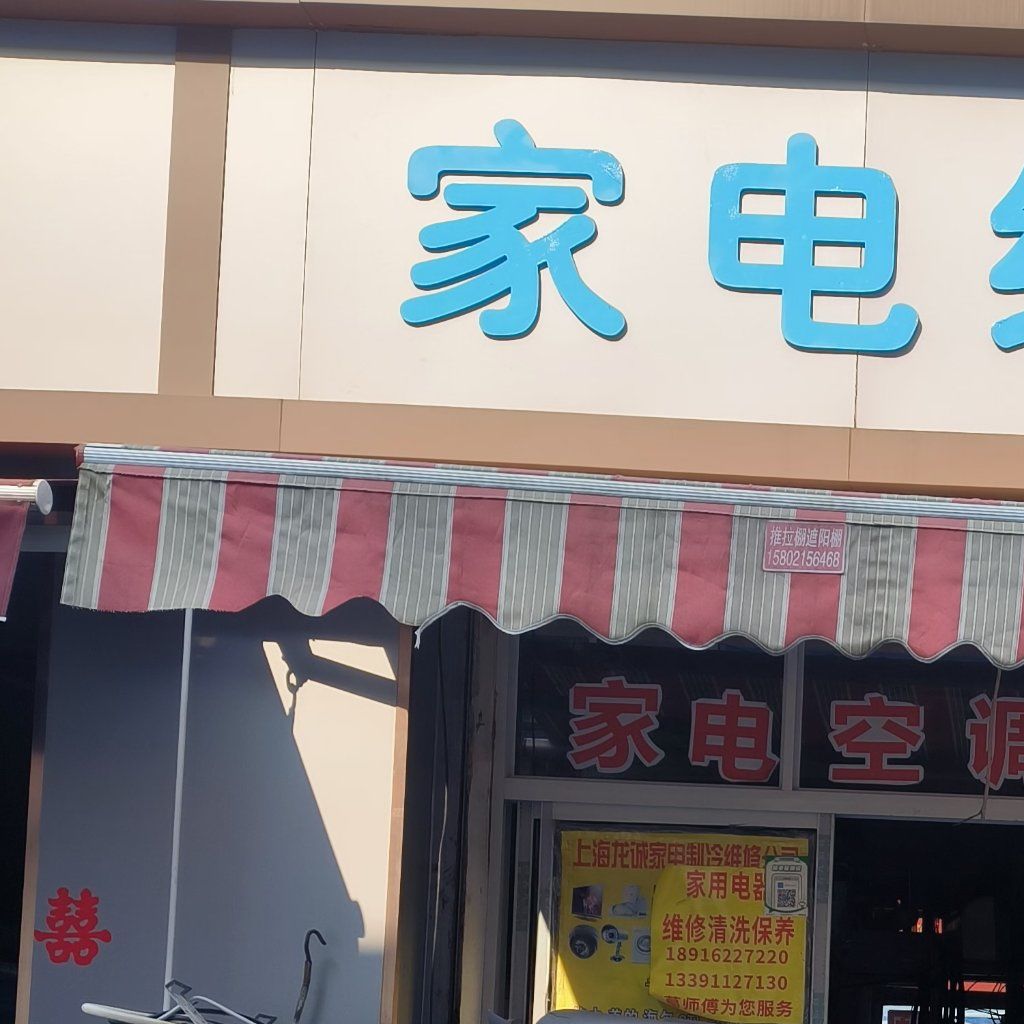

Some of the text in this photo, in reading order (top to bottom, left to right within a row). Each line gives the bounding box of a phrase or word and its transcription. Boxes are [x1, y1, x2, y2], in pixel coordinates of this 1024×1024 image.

[767, 550, 840, 567] 15802156468
[662, 913, 795, 946] 维修清洗保养
[666, 947, 789, 964] 18916227220
[665, 973, 788, 990] 13391127130
